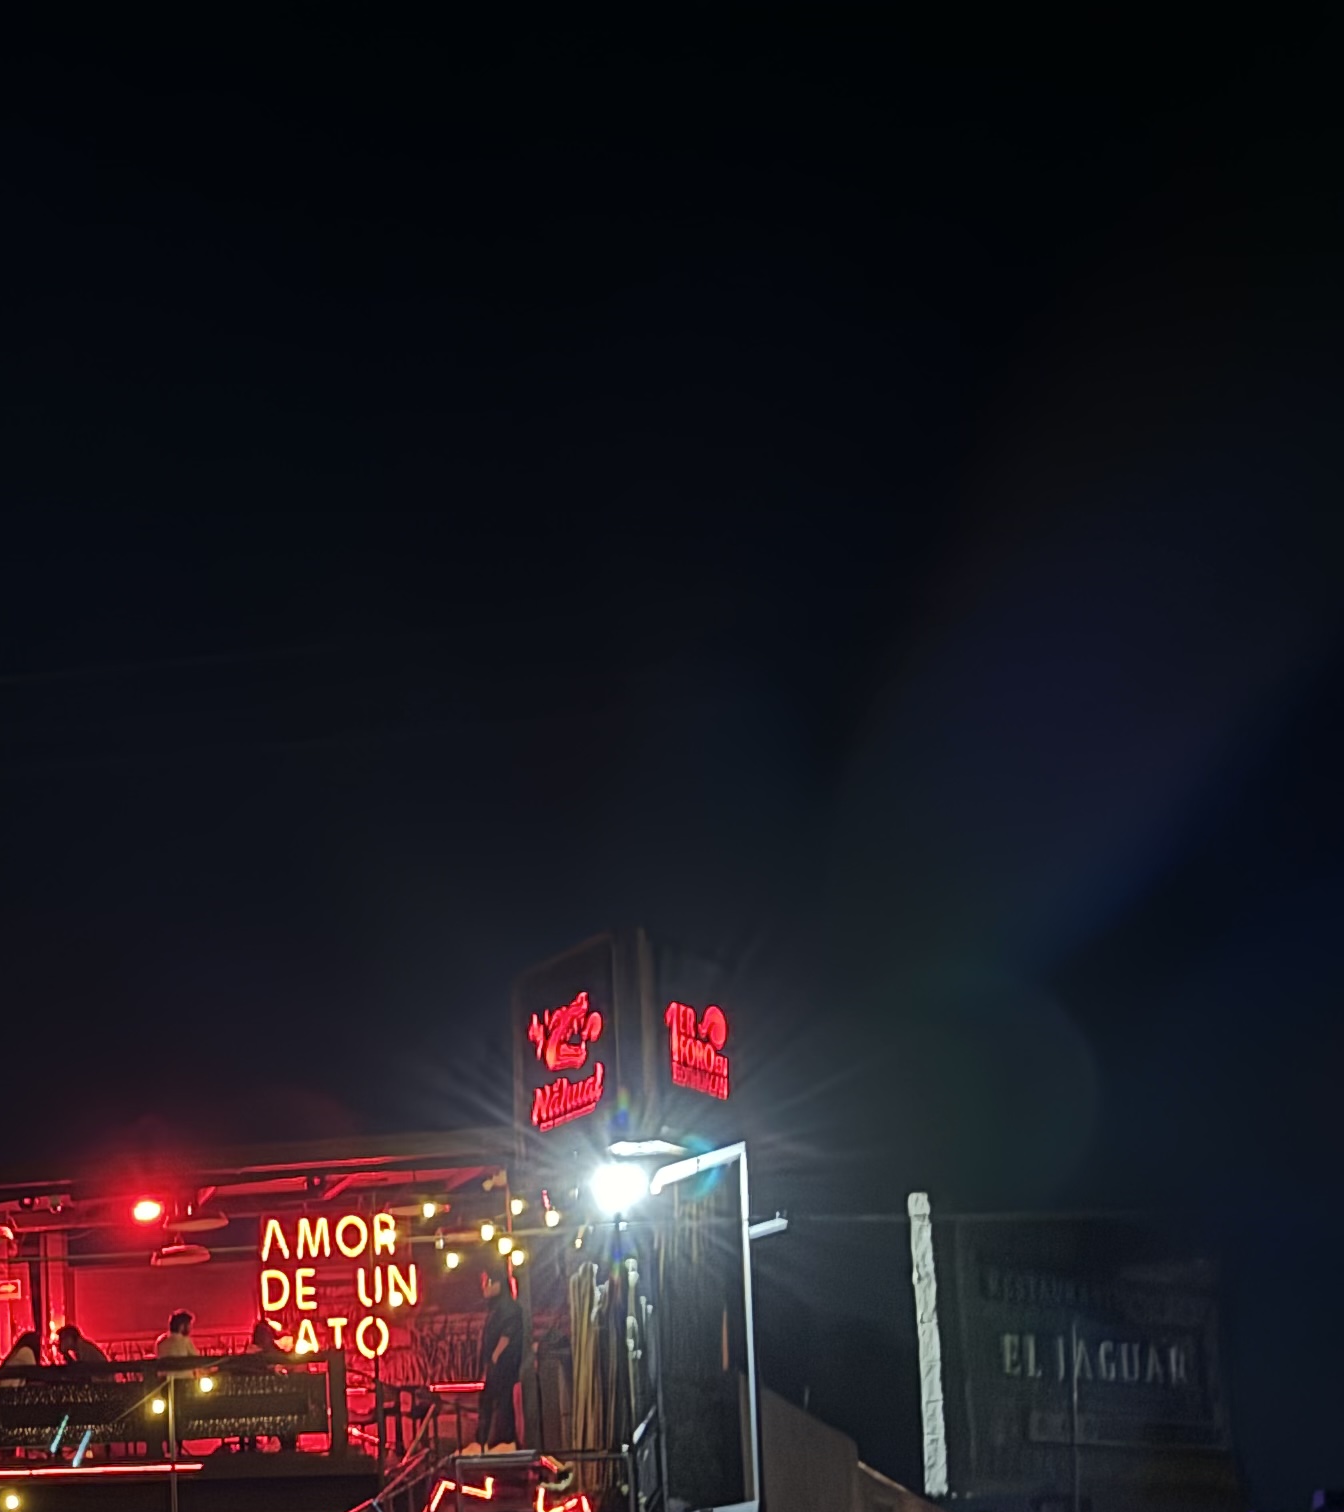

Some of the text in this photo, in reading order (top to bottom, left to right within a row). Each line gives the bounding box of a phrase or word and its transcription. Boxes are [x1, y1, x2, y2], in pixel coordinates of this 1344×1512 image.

[679, 1034, 715, 1073] FORO
[261, 1212, 397, 1262] AMOR
[260, 1263, 418, 1312] DE UN
[264, 1315, 390, 1360] ATO
[1002, 1333, 1042, 1378] EL
